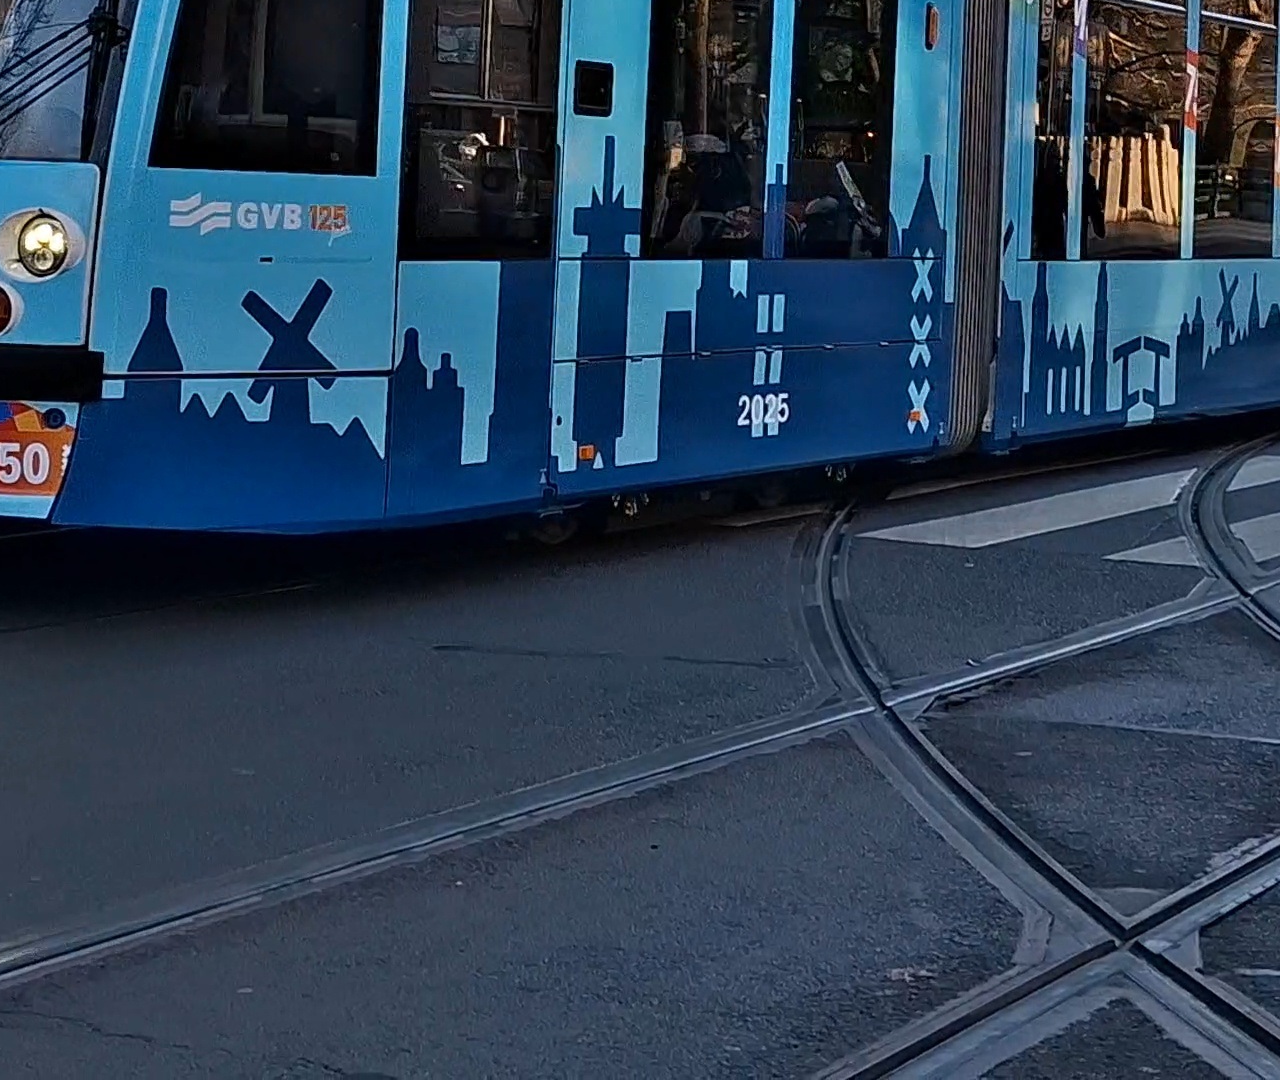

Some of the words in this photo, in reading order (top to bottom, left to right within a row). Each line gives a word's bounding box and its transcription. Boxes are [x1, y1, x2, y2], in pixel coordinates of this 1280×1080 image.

[236, 201, 302, 230] GVB
[309, 203, 348, 232] 125
[737, 392, 789, 426] 2025
